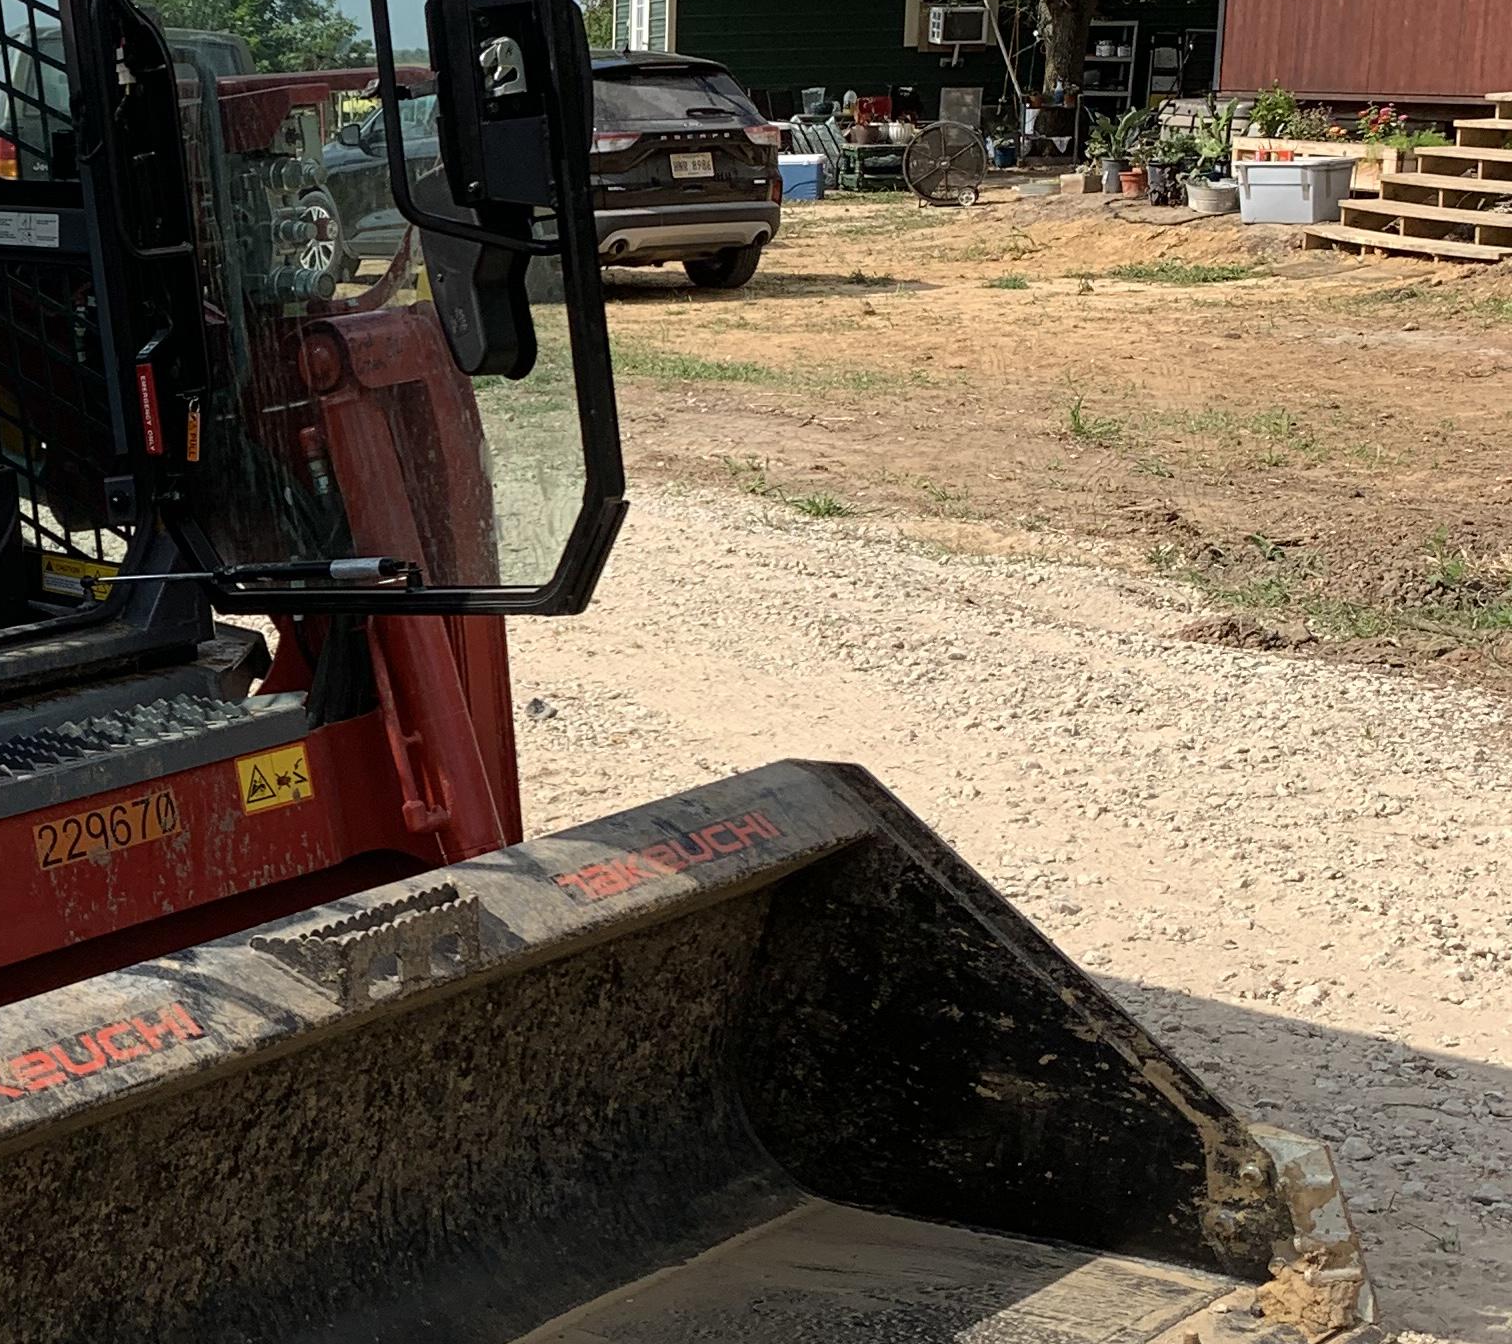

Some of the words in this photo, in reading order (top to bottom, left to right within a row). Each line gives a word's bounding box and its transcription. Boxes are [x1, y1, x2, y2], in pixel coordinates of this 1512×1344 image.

[140, 375, 152, 426] EMERGENCY
[147, 429, 156, 451] ONLY
[38, 791, 176, 868] 229670
